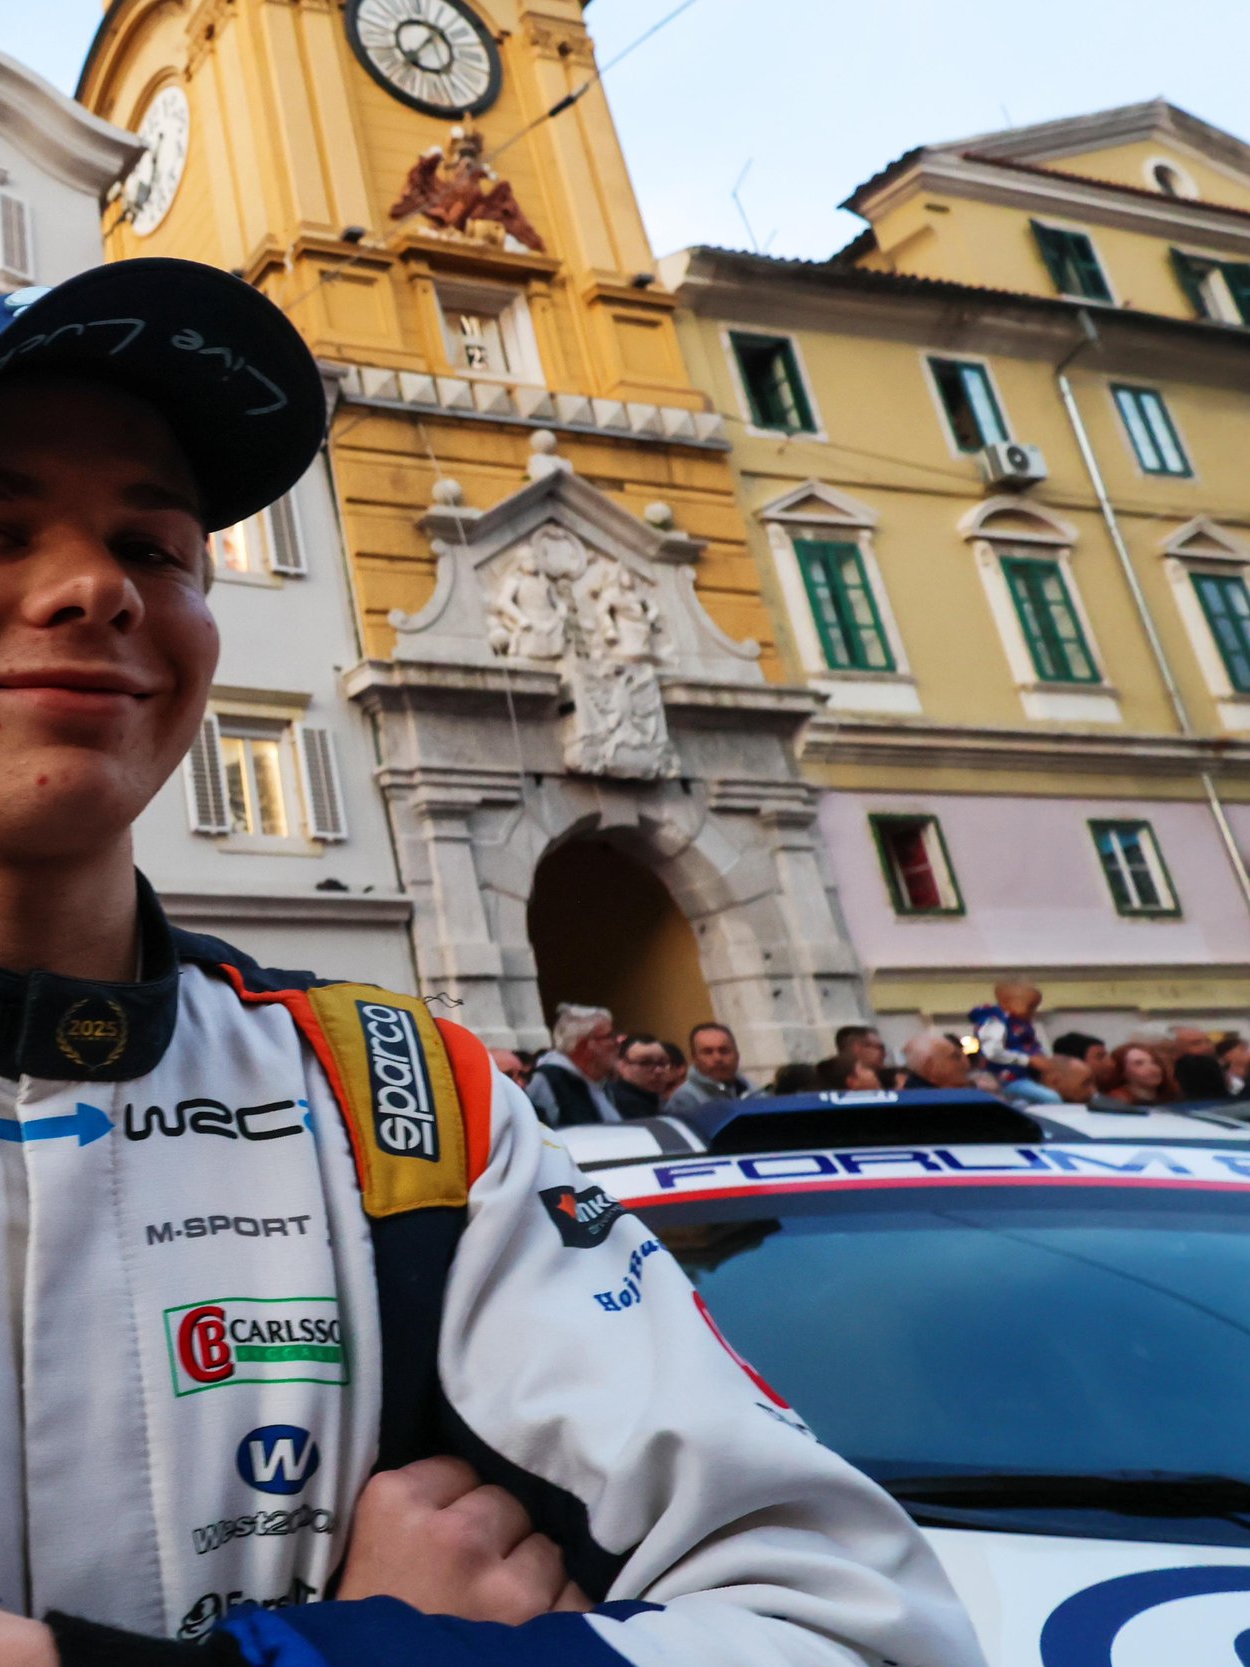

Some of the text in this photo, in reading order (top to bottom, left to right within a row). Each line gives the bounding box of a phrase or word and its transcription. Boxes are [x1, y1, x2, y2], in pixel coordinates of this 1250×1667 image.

[67, 1019, 118, 1037] 2025
[361, 1004, 435, 1156] sparco
[229, 1318, 341, 1344] CARLSSO
[249, 1438, 317, 1483] W
